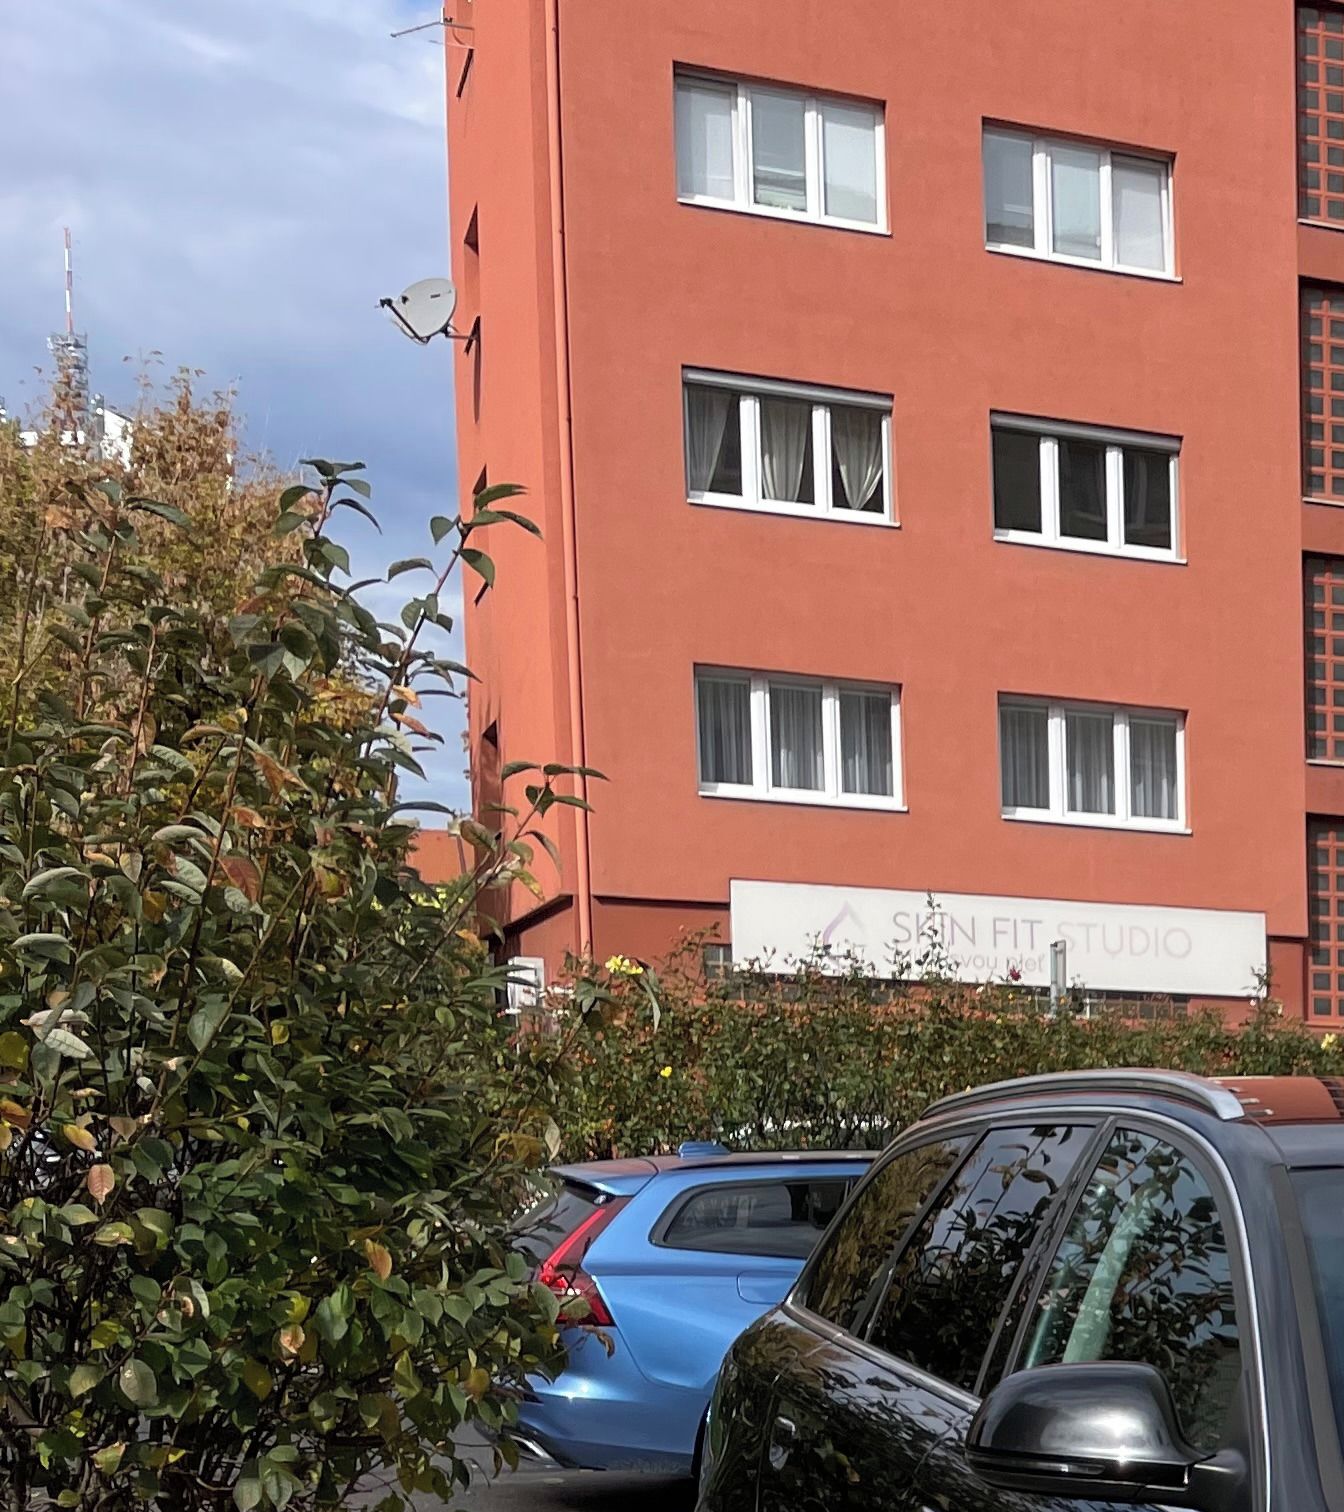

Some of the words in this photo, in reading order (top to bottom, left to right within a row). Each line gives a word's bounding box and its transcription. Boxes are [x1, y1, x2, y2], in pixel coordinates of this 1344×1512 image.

[893, 911, 976, 947] SKIN
[993, 917, 1043, 950] FIT
[1057, 922, 1192, 959] STUDIO
